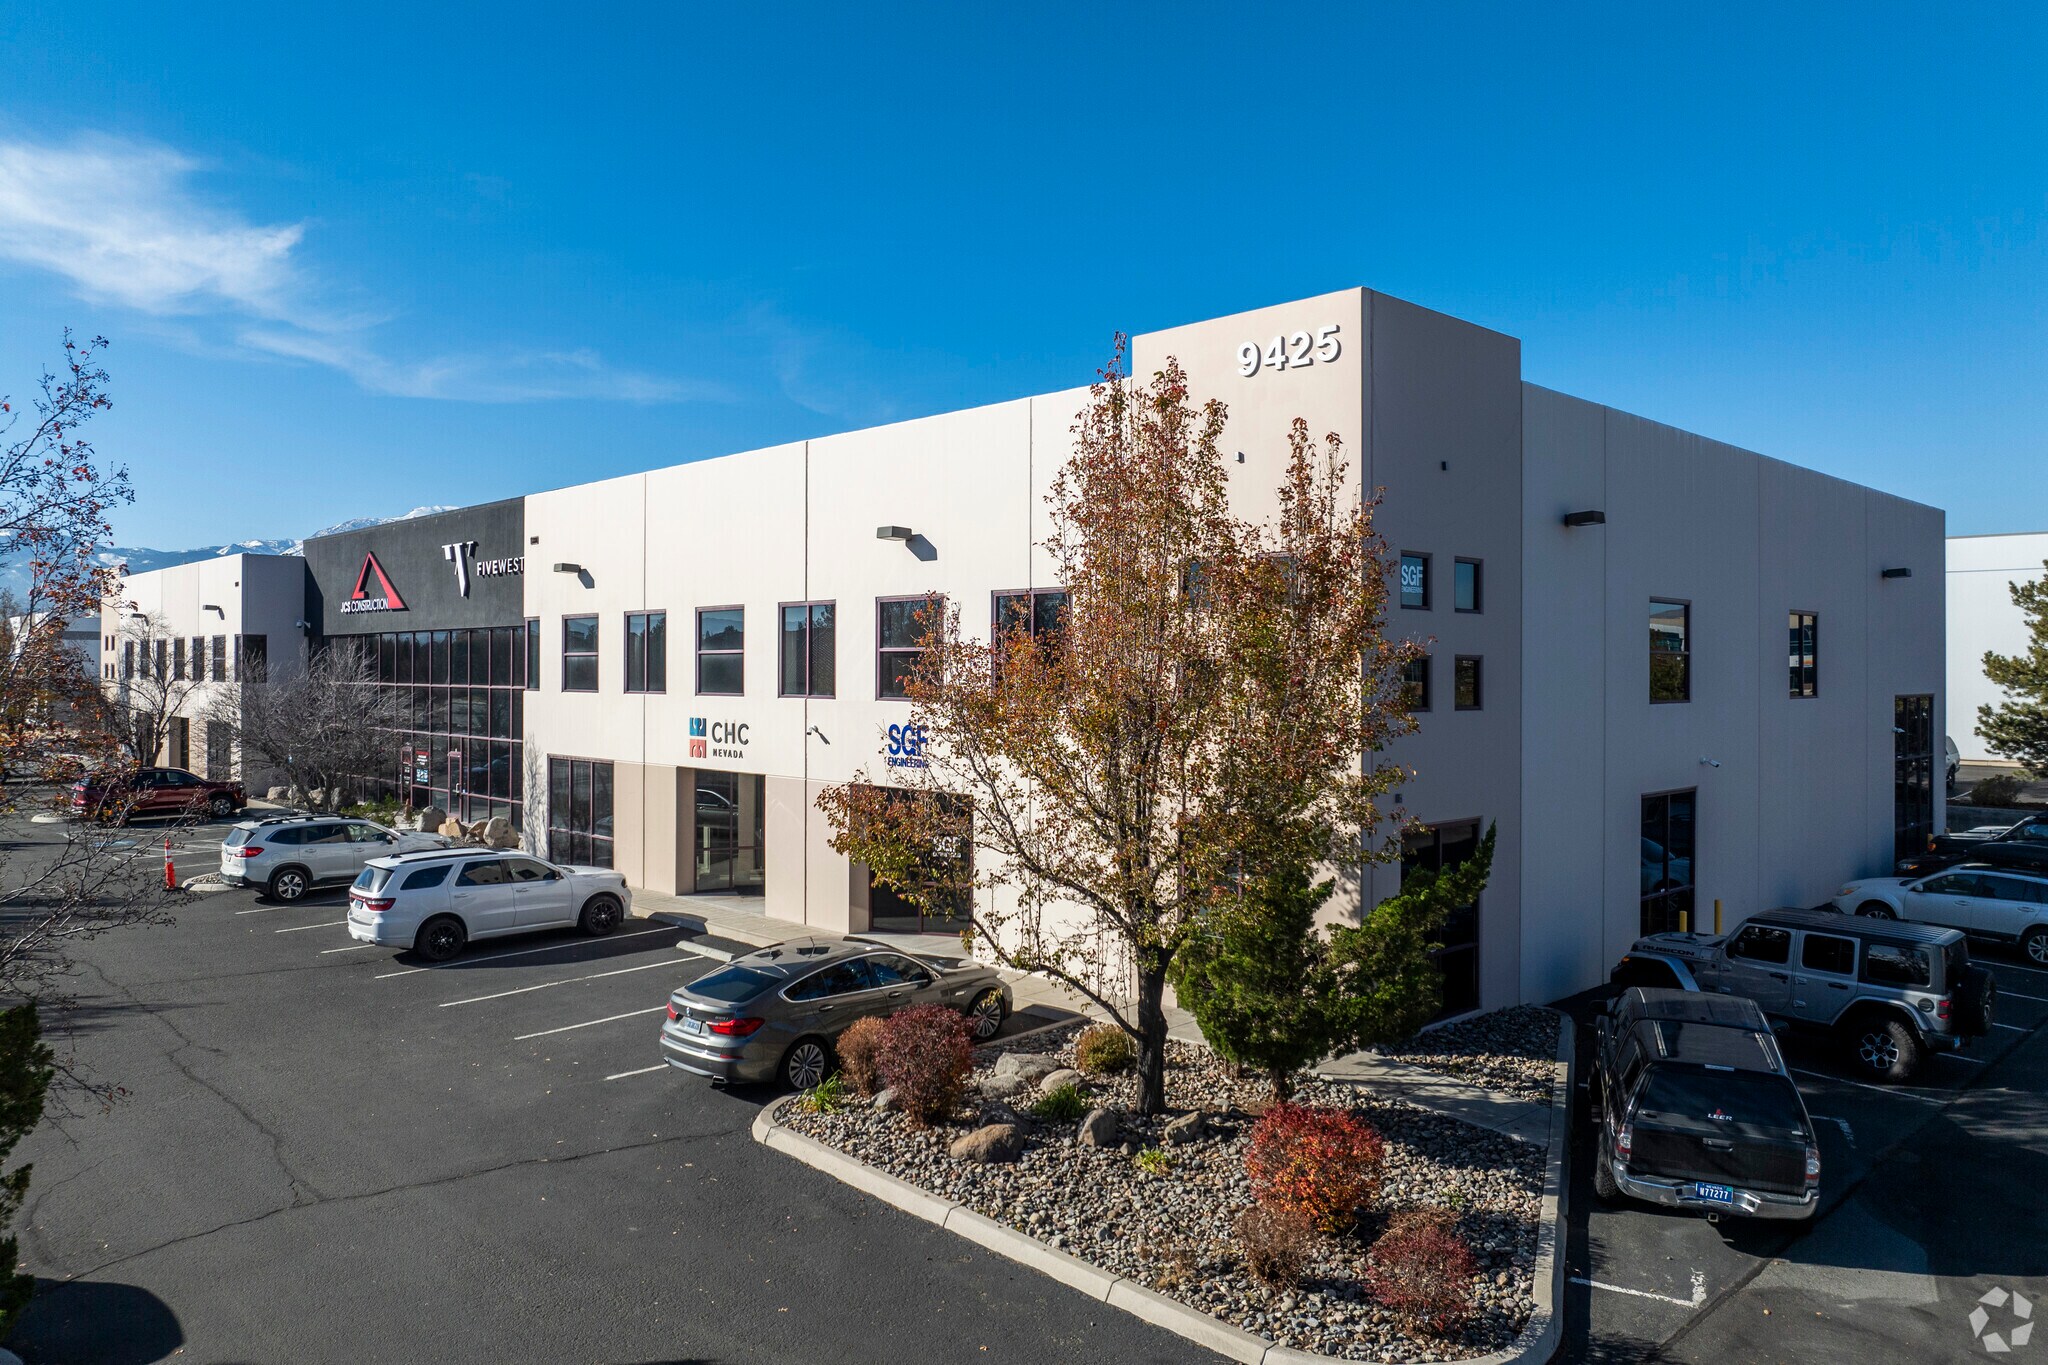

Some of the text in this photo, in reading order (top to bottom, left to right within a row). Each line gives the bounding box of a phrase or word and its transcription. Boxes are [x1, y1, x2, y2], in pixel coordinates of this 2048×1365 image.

[1236, 324, 1341, 378] 9425
[476, 556, 525, 576] FIVEWEST
[1401, 564, 1423, 586] SGF
[340, 598, 389, 613] JCS CONSTRUCTION
[711, 721, 750, 746] CHC
[887, 723, 929, 756] SGF
[712, 748, 744, 759] NEVADA
[1642, 945, 1695, 956] RUBICON
[1707, 1113, 1733, 1121] LEER
